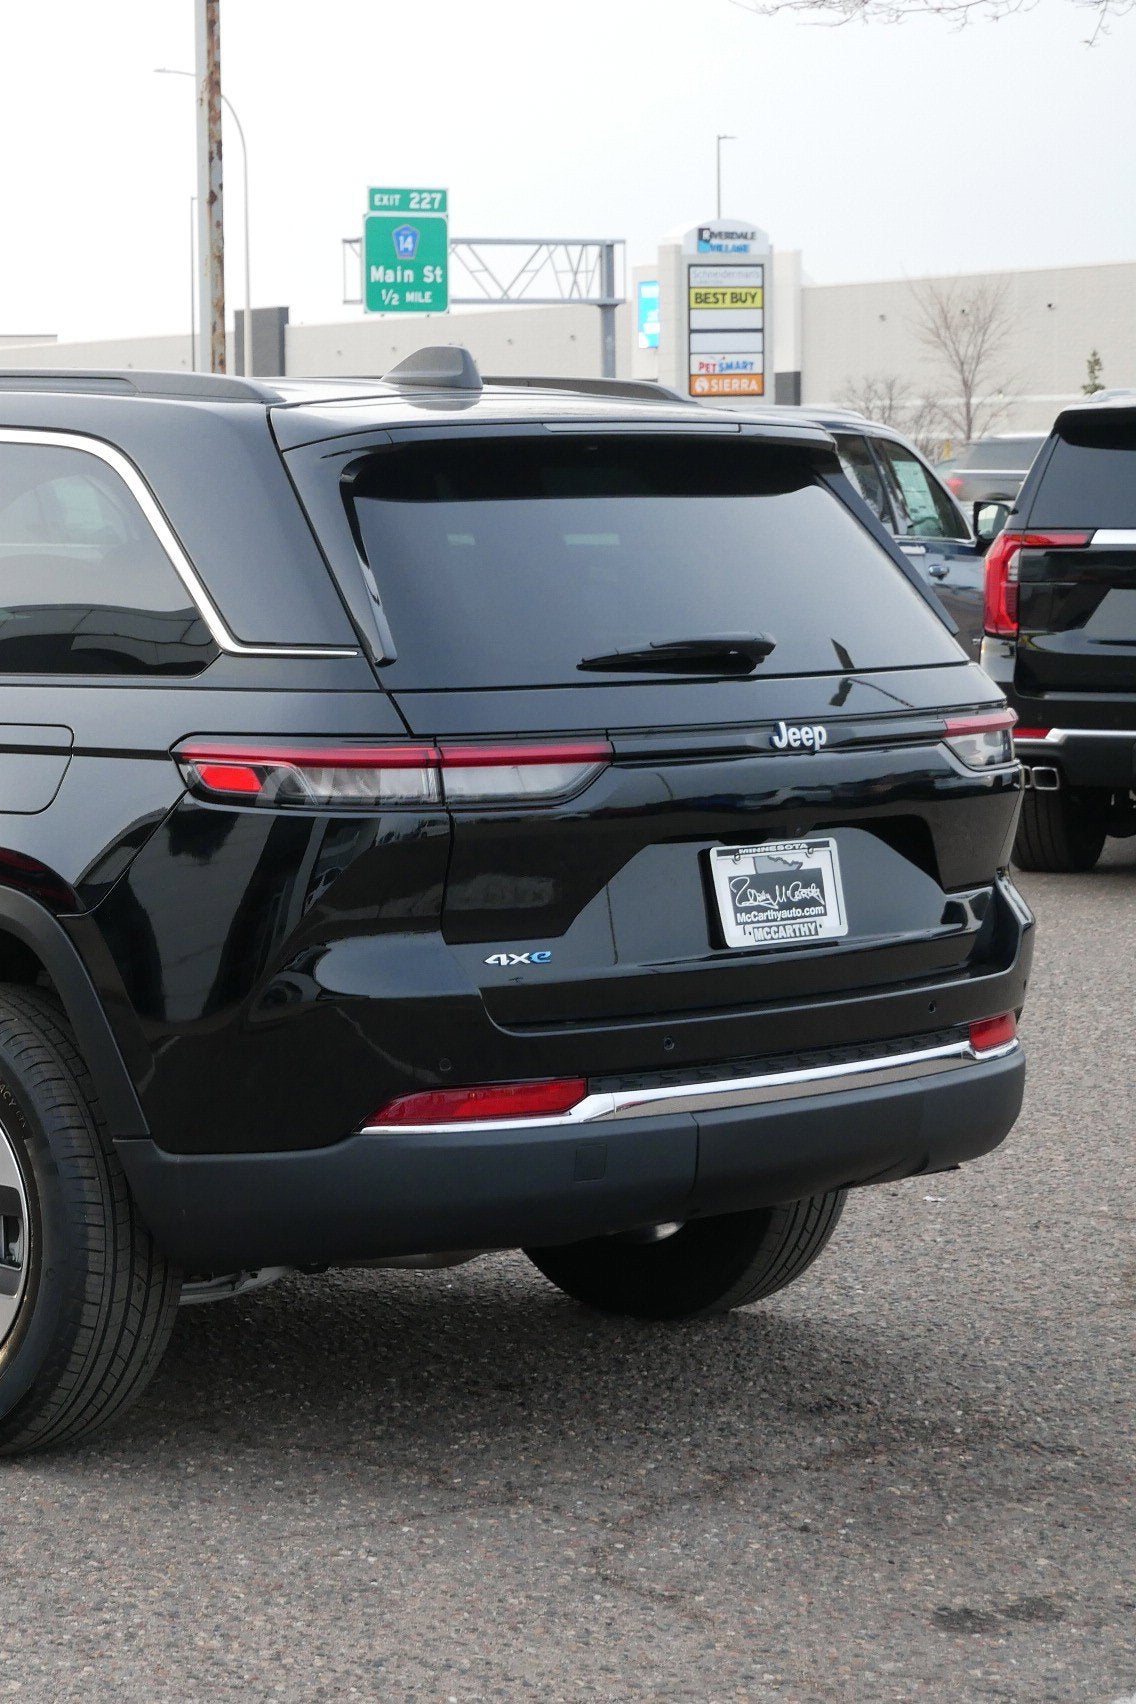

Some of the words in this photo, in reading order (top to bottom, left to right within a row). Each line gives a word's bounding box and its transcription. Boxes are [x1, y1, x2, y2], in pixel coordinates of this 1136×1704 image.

[373, 193, 401, 206] EXIT
[409, 192, 442, 209] 227
[399, 235, 413, 251] 14
[370, 265, 414, 283] Main
[423, 265, 443, 283] St
[405, 291, 433, 303] MILE
[694, 292, 728, 304] BEST
[730, 292, 757, 304] BUY
[711, 378, 758, 392] SIERRA
[772, 721, 827, 751] Jeep
[739, 843, 809, 853] MINNESOTA
[736, 905, 824, 924] McCarthyauto.com
[754, 921, 817, 942] MCCARTHY
